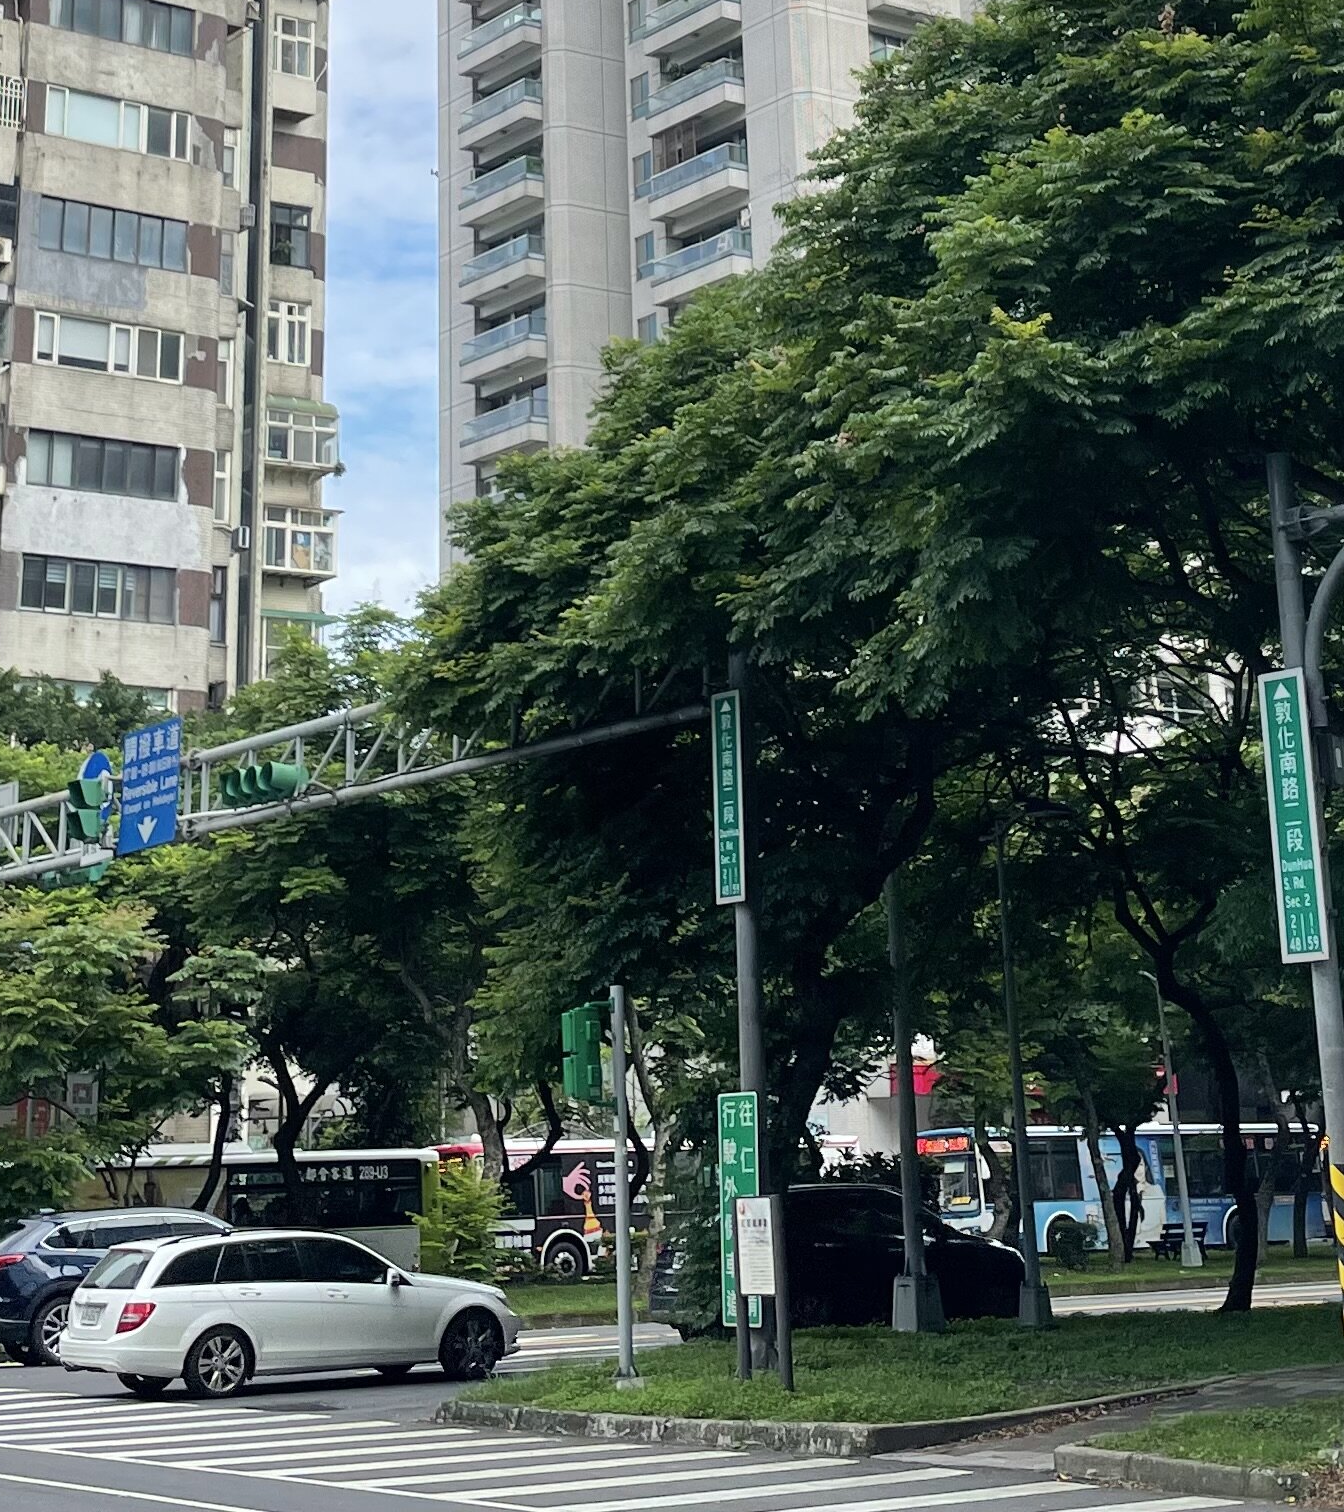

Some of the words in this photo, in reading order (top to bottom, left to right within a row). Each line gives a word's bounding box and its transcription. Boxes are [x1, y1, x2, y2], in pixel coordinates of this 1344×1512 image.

[1273, 701, 1305, 853] 敦化南路二段
[1281, 857, 1313, 872] DunHua
[1304, 893, 1311, 906] 2
